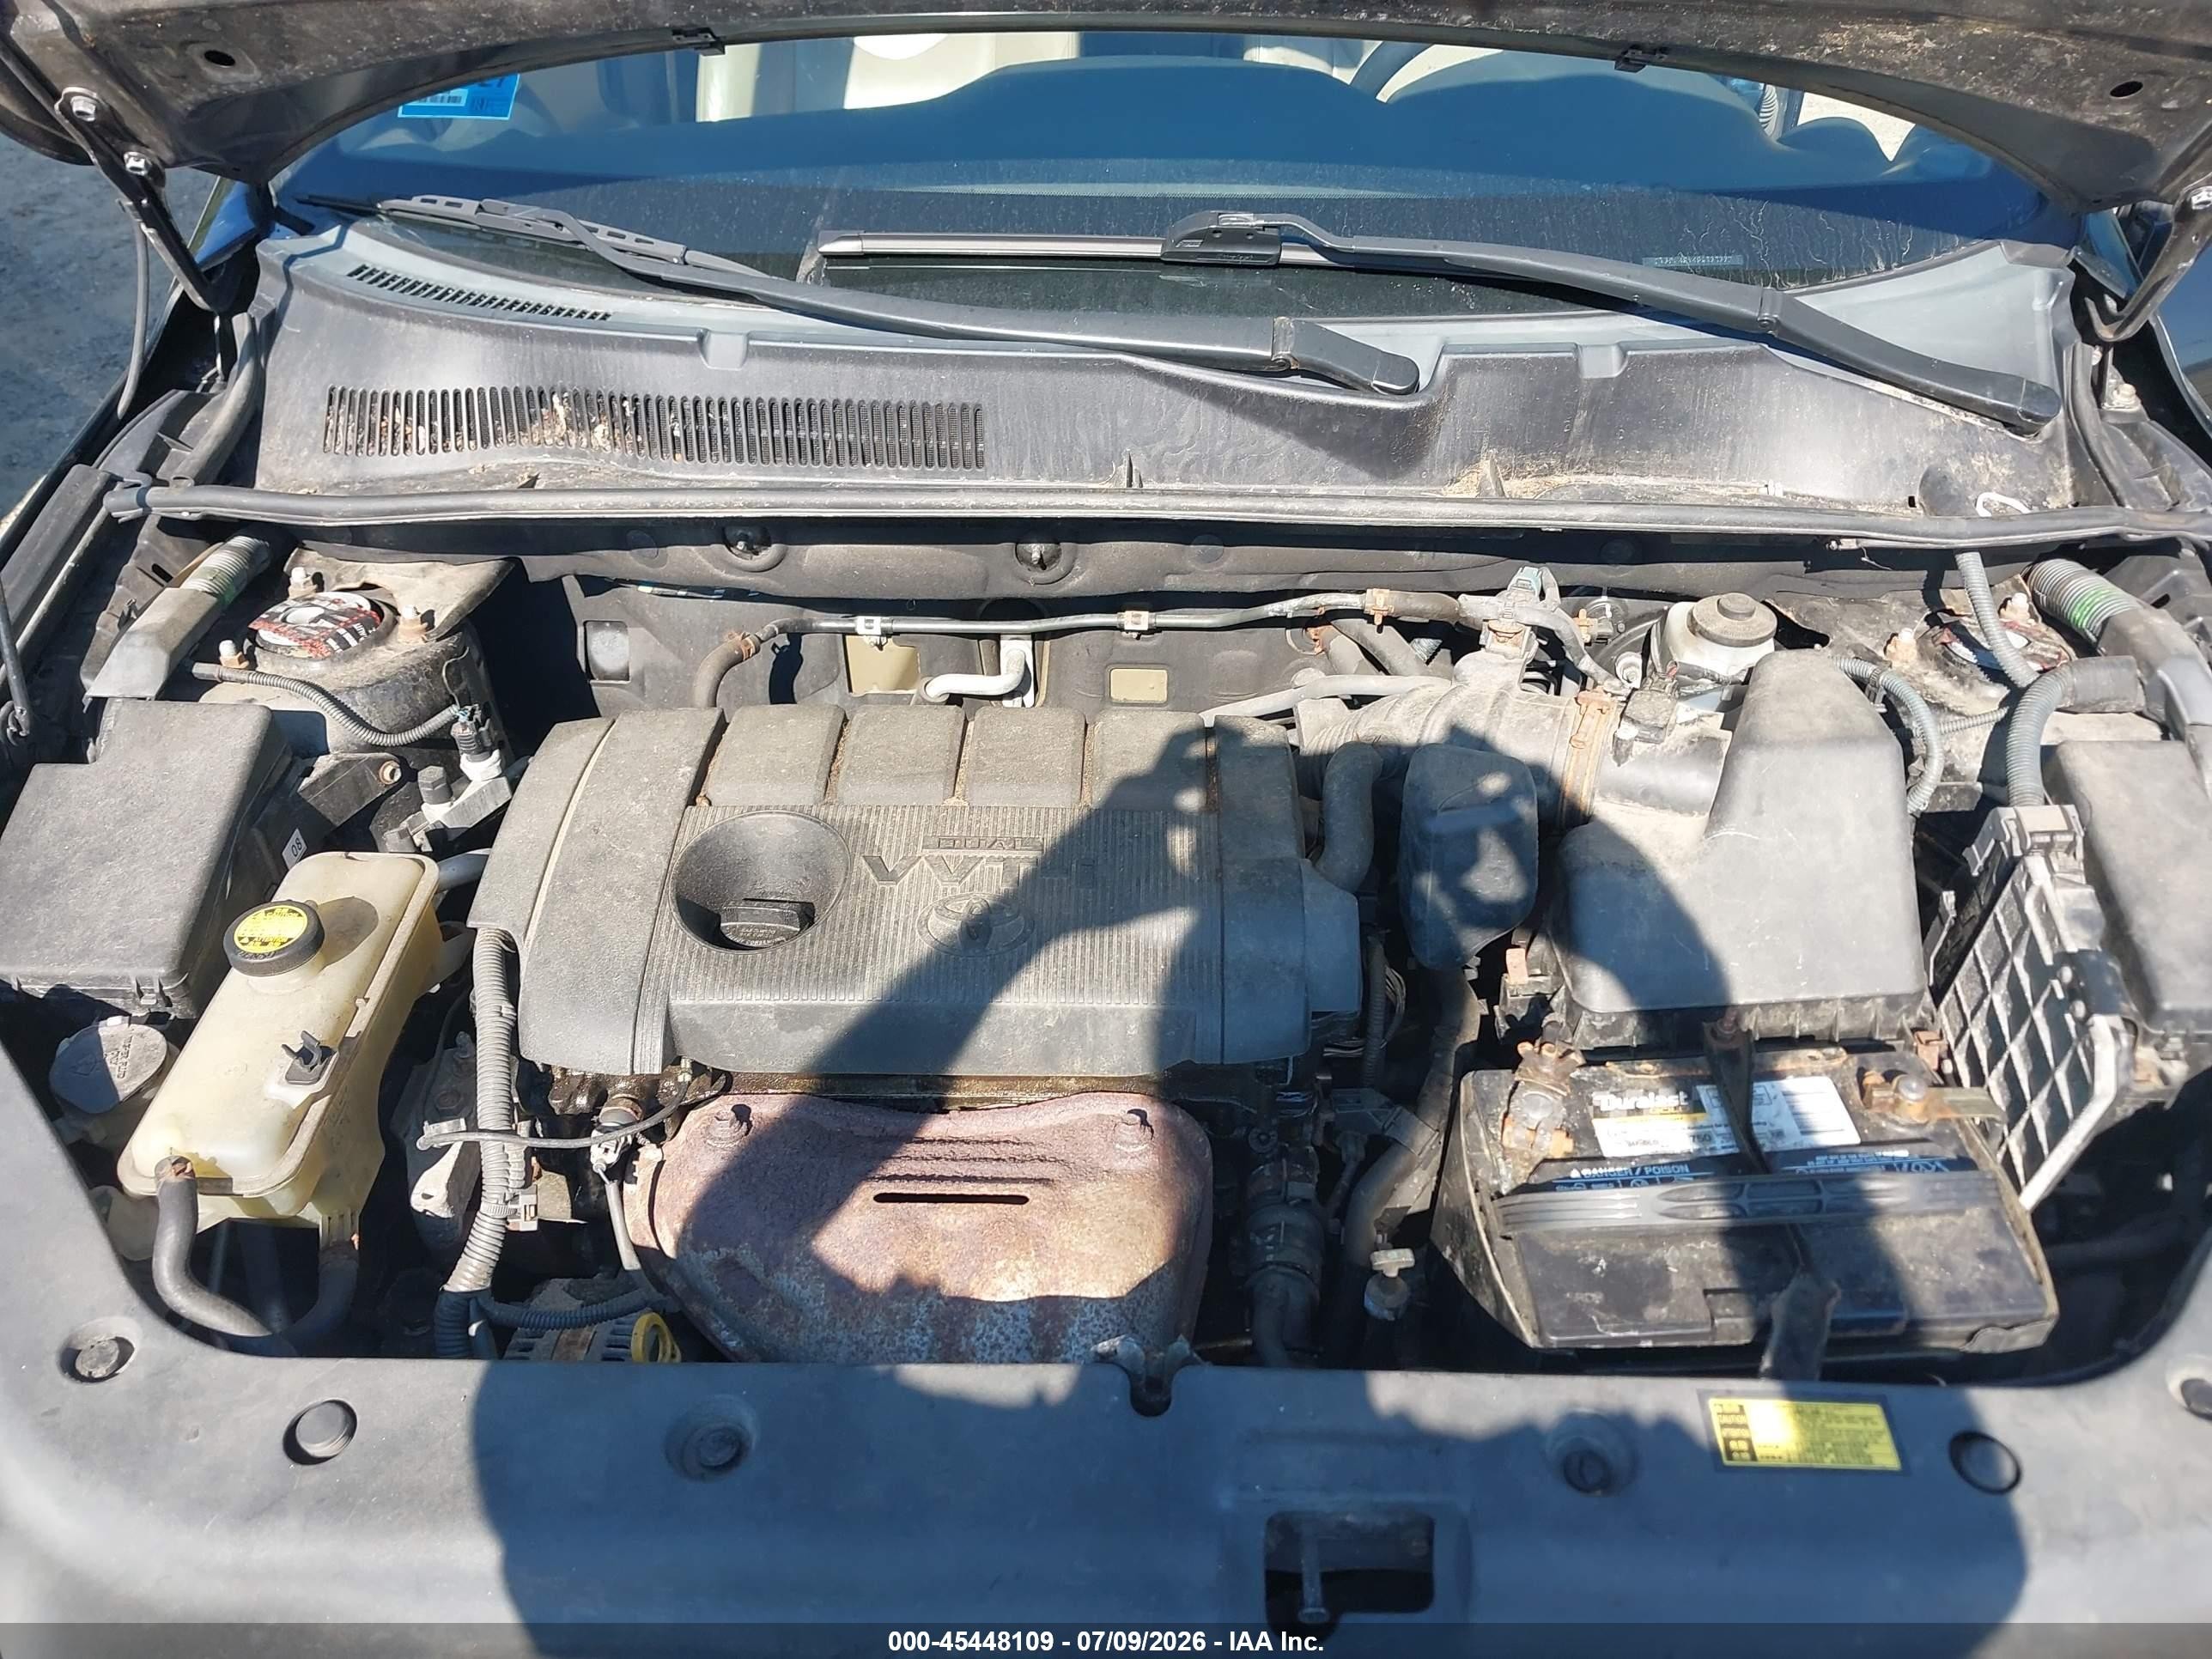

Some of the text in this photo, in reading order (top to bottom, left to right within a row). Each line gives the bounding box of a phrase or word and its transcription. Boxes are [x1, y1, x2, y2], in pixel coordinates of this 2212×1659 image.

[1594, 1091, 1689, 1111] Duralast
[1581, 1165, 1632, 1178] DANGER
[1644, 1164, 1691, 1176] POISON
